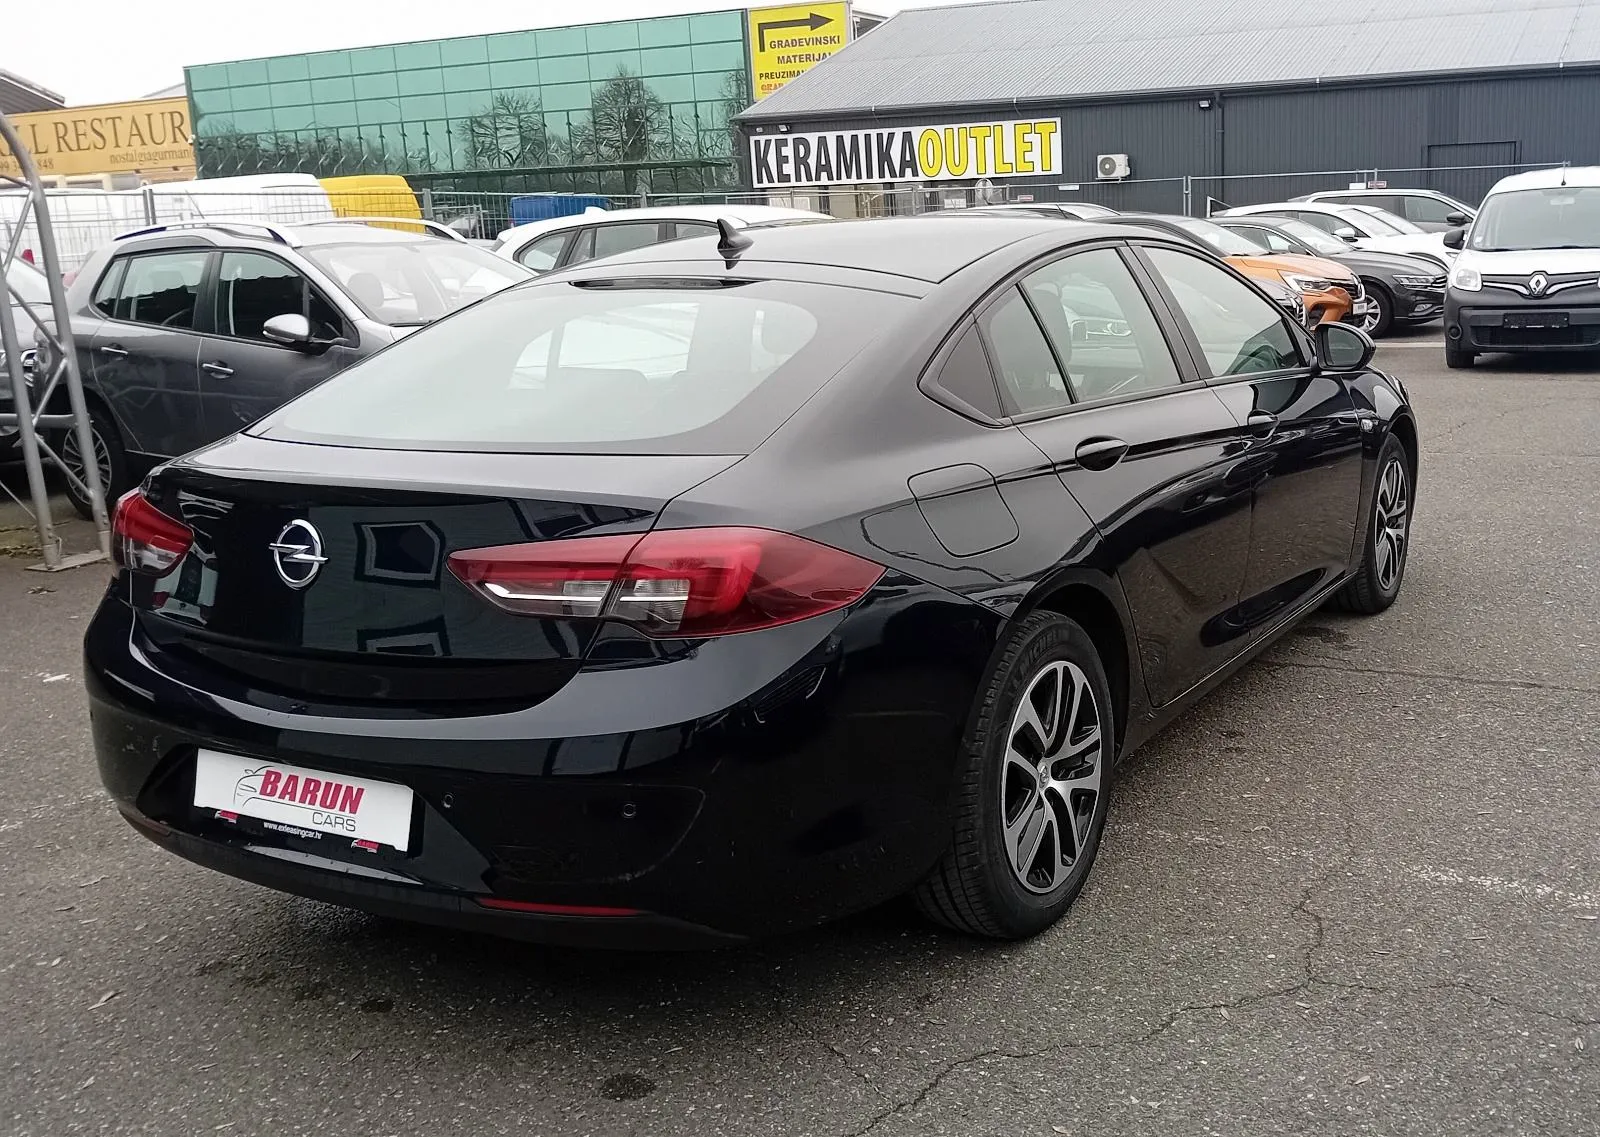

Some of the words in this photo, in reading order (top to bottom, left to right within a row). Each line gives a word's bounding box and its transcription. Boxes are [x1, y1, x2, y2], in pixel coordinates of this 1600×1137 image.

[769, 35, 841, 49] GRAĐEVINSKI
[777, 52, 832, 65] MATERIJA
[759, 70, 807, 80] PREUZIMA
[259, 769, 365, 815] BARUN
[312, 812, 356, 832] CARS
